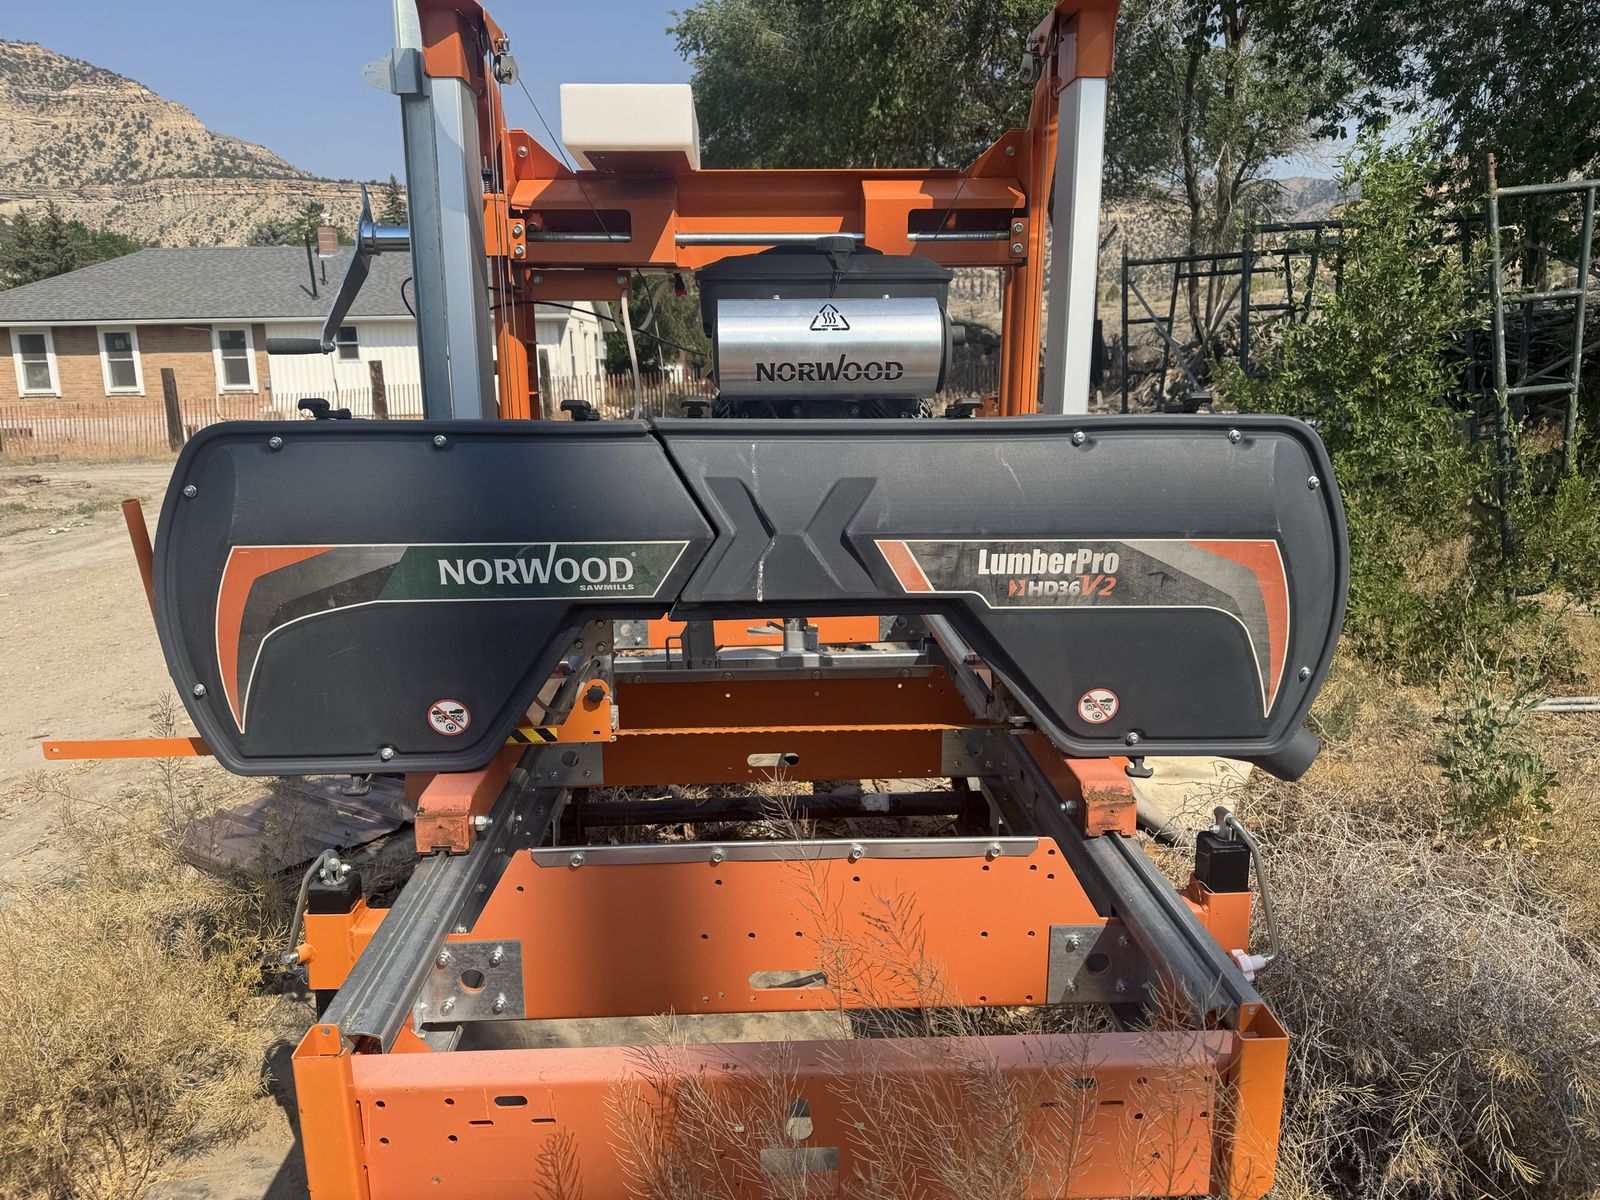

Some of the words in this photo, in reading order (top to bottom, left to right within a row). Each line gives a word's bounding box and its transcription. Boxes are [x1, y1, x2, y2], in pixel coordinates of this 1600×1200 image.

[756, 354, 904, 382] NORWOOD
[437, 544, 634, 585] NORWOOD
[978, 549, 1120, 575] LumberPro
[579, 583, 635, 591] SAWMILLS
